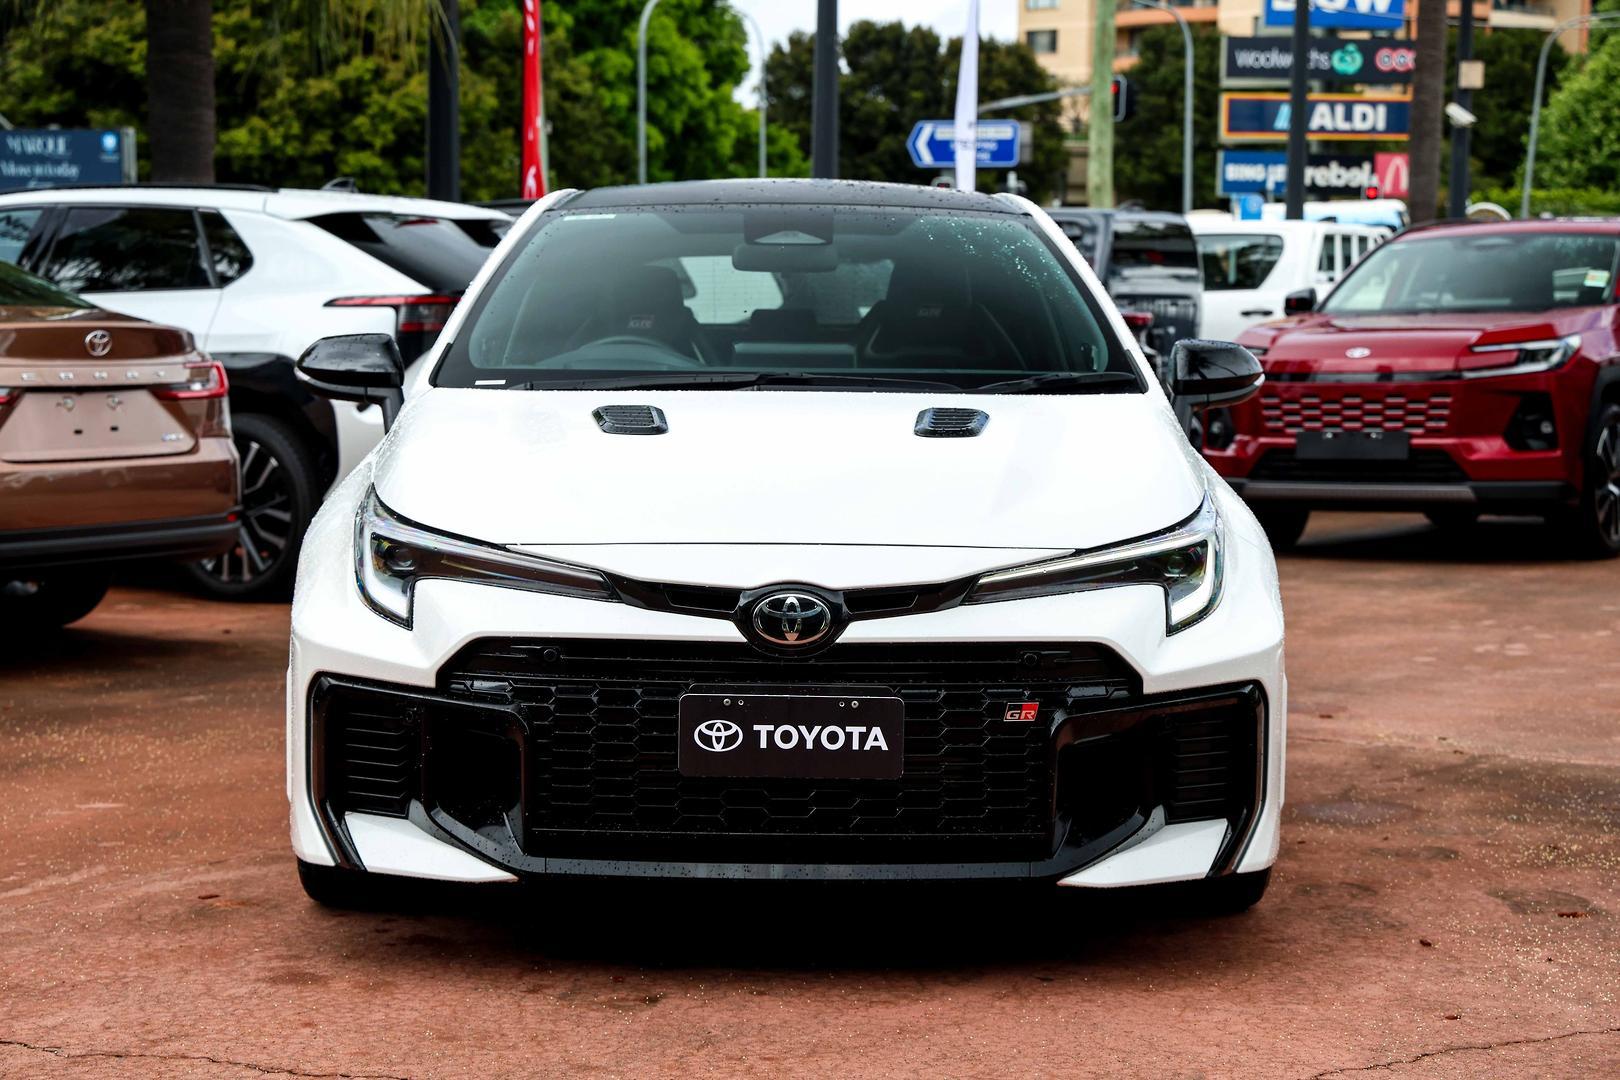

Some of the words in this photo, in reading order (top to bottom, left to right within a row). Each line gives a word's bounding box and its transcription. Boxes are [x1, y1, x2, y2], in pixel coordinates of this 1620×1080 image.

[1309, 103, 1387, 131] ALDI
[1303, 161, 1371, 187] rebel
[1006, 710, 1036, 720] GR
[753, 724, 889, 751] TOYOTA
